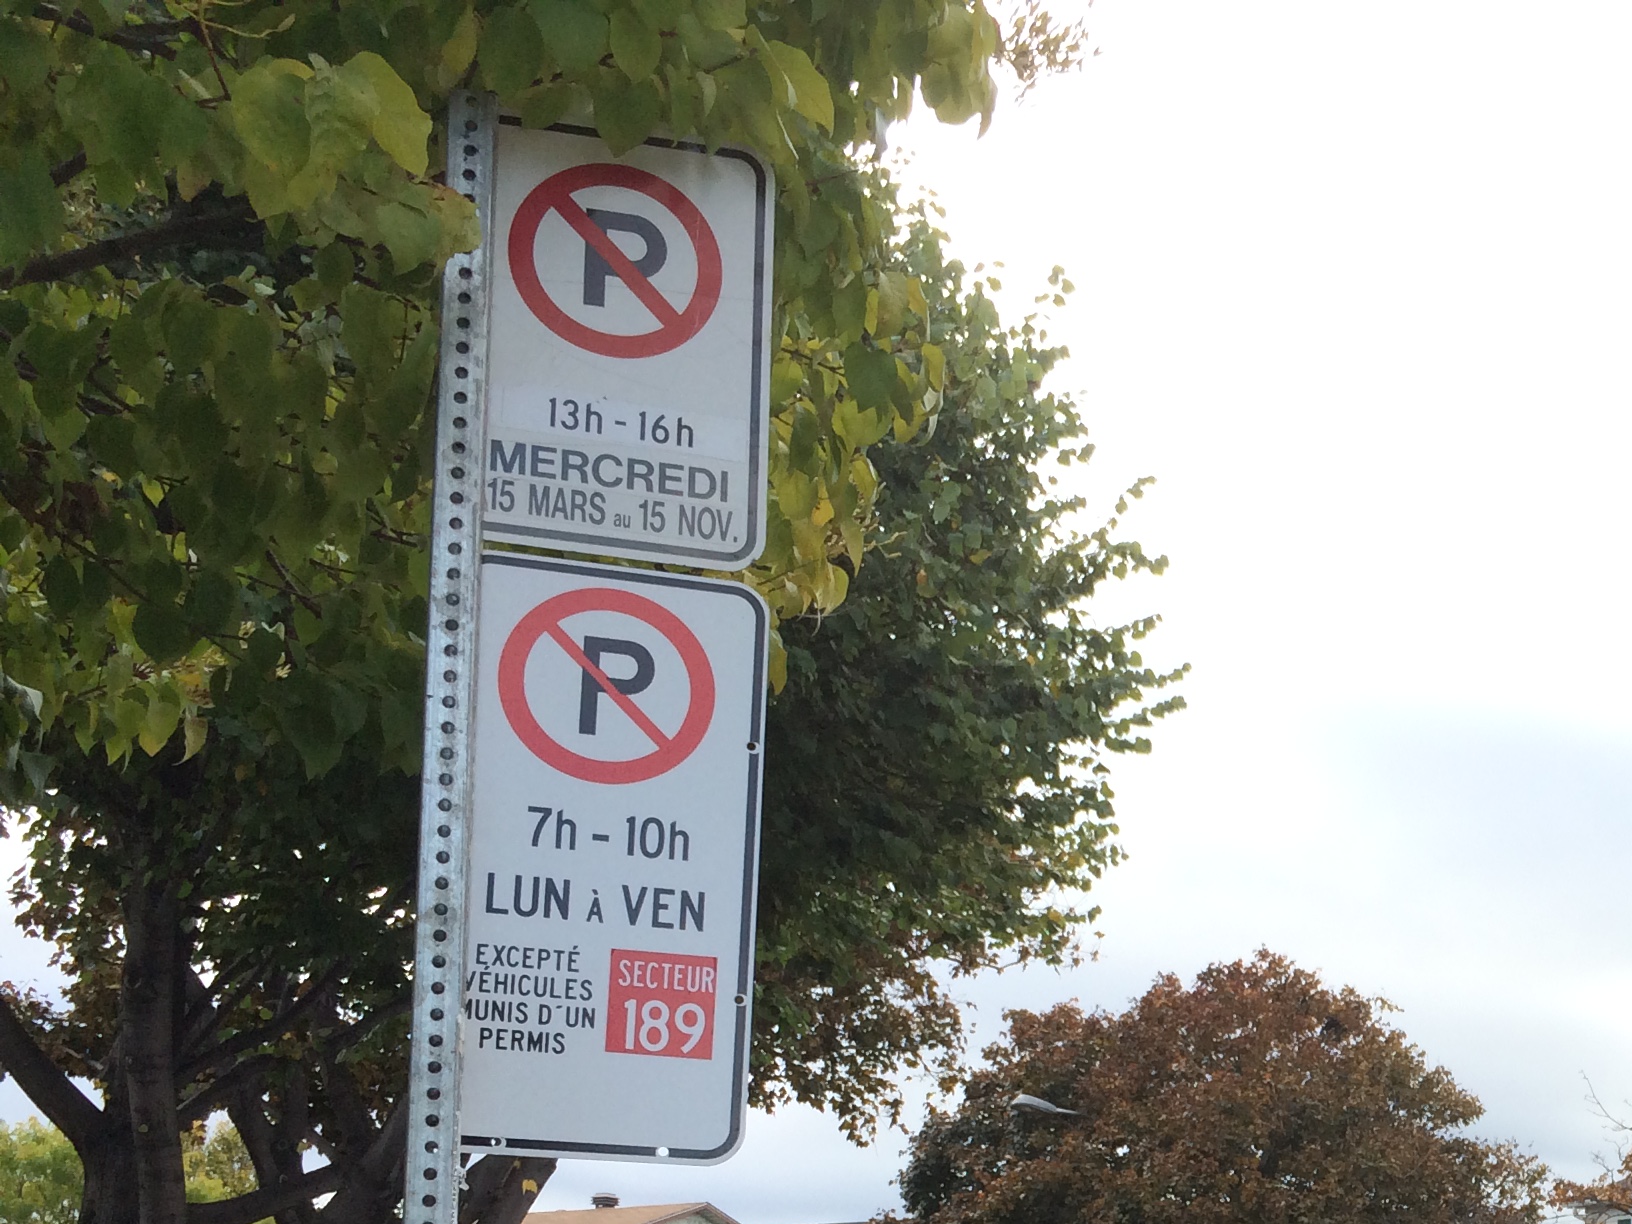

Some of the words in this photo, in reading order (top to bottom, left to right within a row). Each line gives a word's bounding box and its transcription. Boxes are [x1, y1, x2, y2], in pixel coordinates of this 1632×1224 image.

[549, 397, 603, 434] 13h
[639, 411, 694, 448] 16h
[490, 439, 729, 502] MERCREDI
[488, 477, 515, 512] 15
[528, 484, 607, 525] MARS
[613, 512, 631, 529] au
[639, 500, 666, 533] 15
[678, 505, 738, 544] NOV.
[527, 805, 577, 850] 7h
[626, 816, 690, 861] 10h
[485, 872, 571, 920] LUN
[586, 889, 604, 923] À
[622, 884, 706, 932] VEN
[476, 943, 580, 973] EXCEPTÉ
[618, 959, 716, 994] SECTEUR
[479, 1027, 565, 1055] PERMIS
[624, 998, 706, 1054] 189
